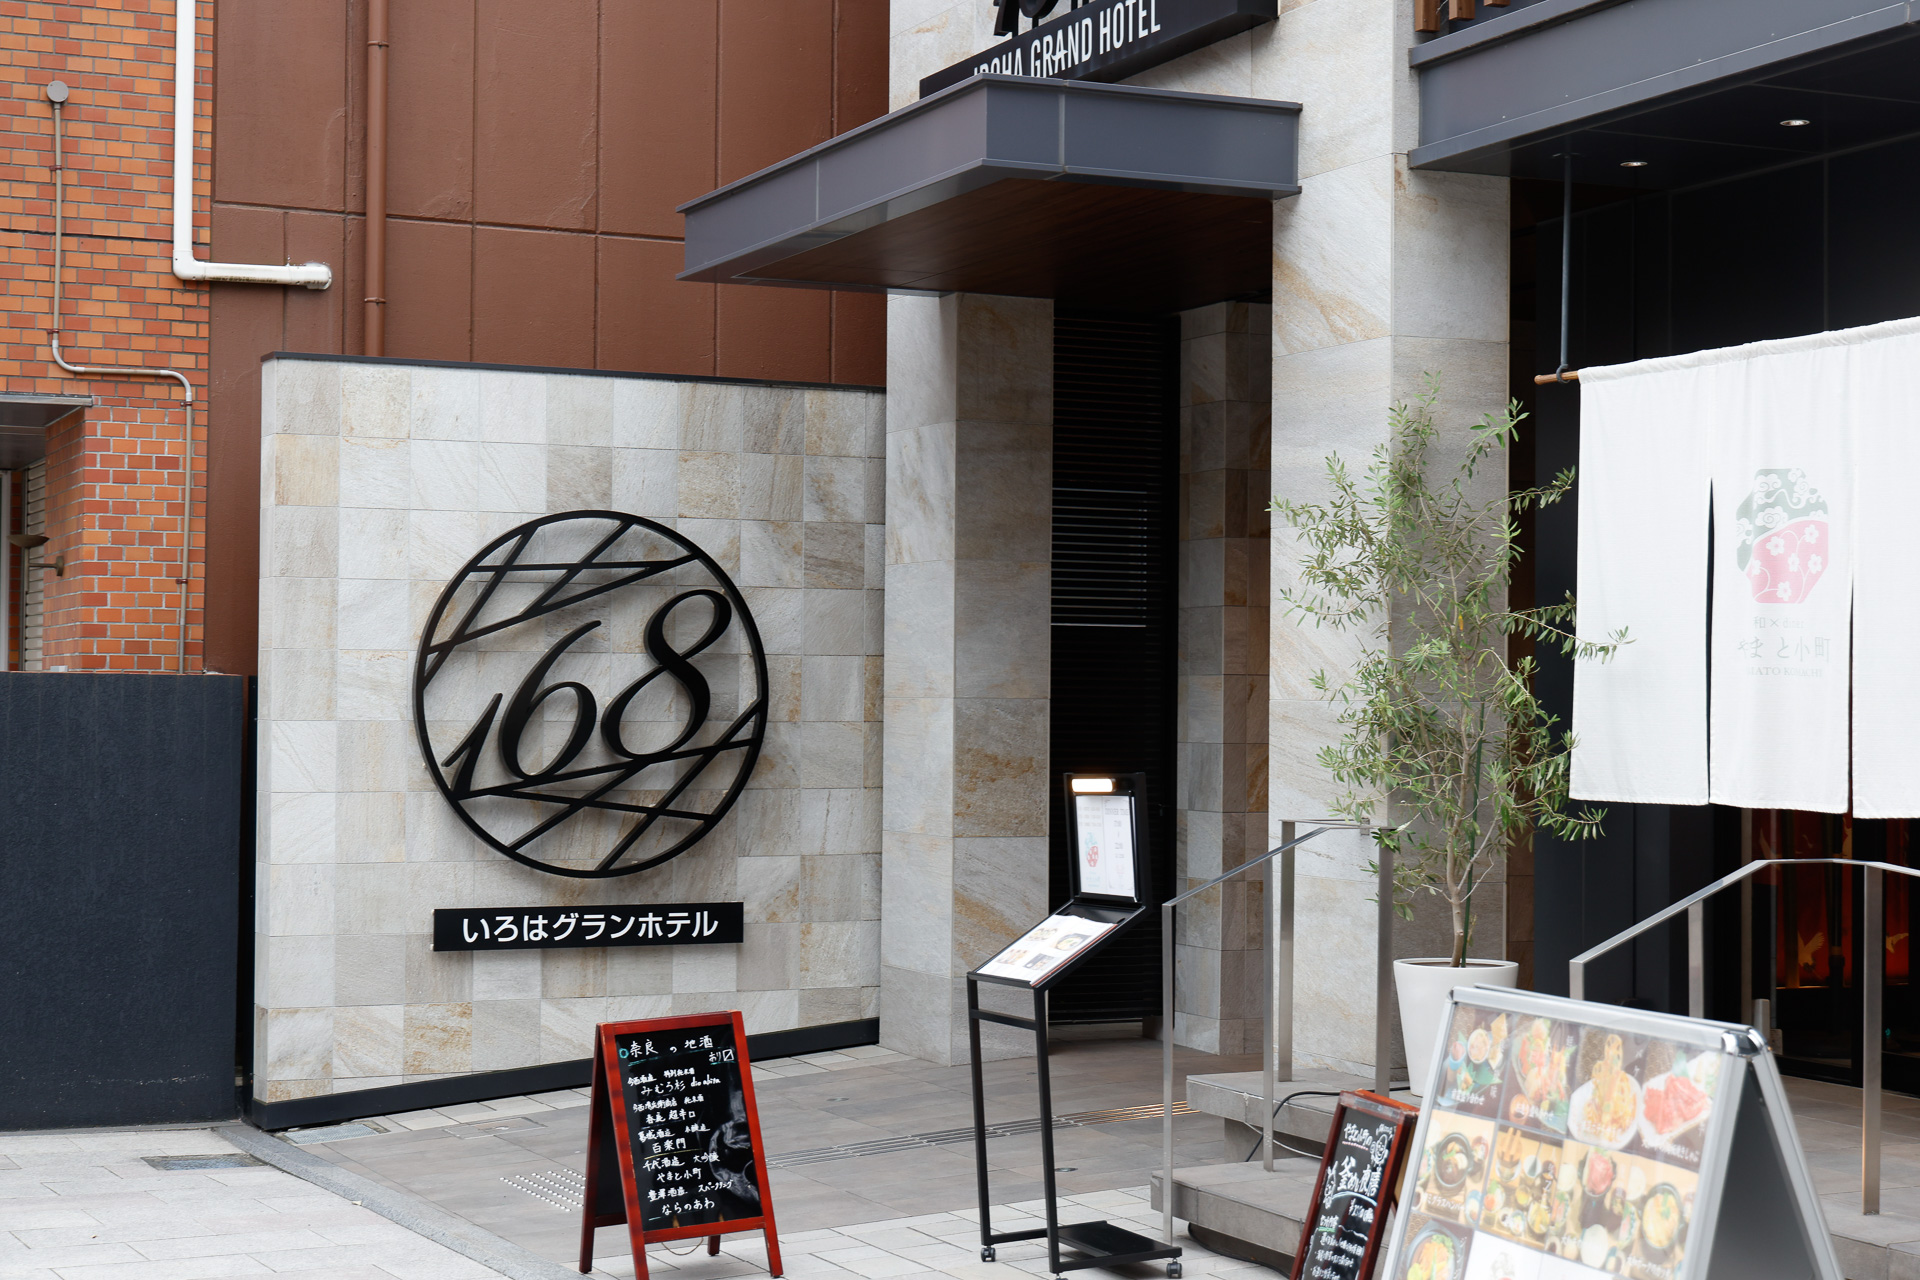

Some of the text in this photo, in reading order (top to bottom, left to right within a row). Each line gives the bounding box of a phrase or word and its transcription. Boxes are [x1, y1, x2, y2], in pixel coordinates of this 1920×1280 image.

[1030, 17, 1093, 78] GRAND
[1099, 0, 1161, 55] HOTEL
[1736, 635, 1831, 662] やまと小町
[441, 588, 732, 800] 168
[462, 910, 719, 943] いろはグランホテル
[656, 1167, 702, 1183] やまと小町
[697, 1179, 734, 1194] スパークリング
[661, 1199, 716, 1216] ならのあわ
